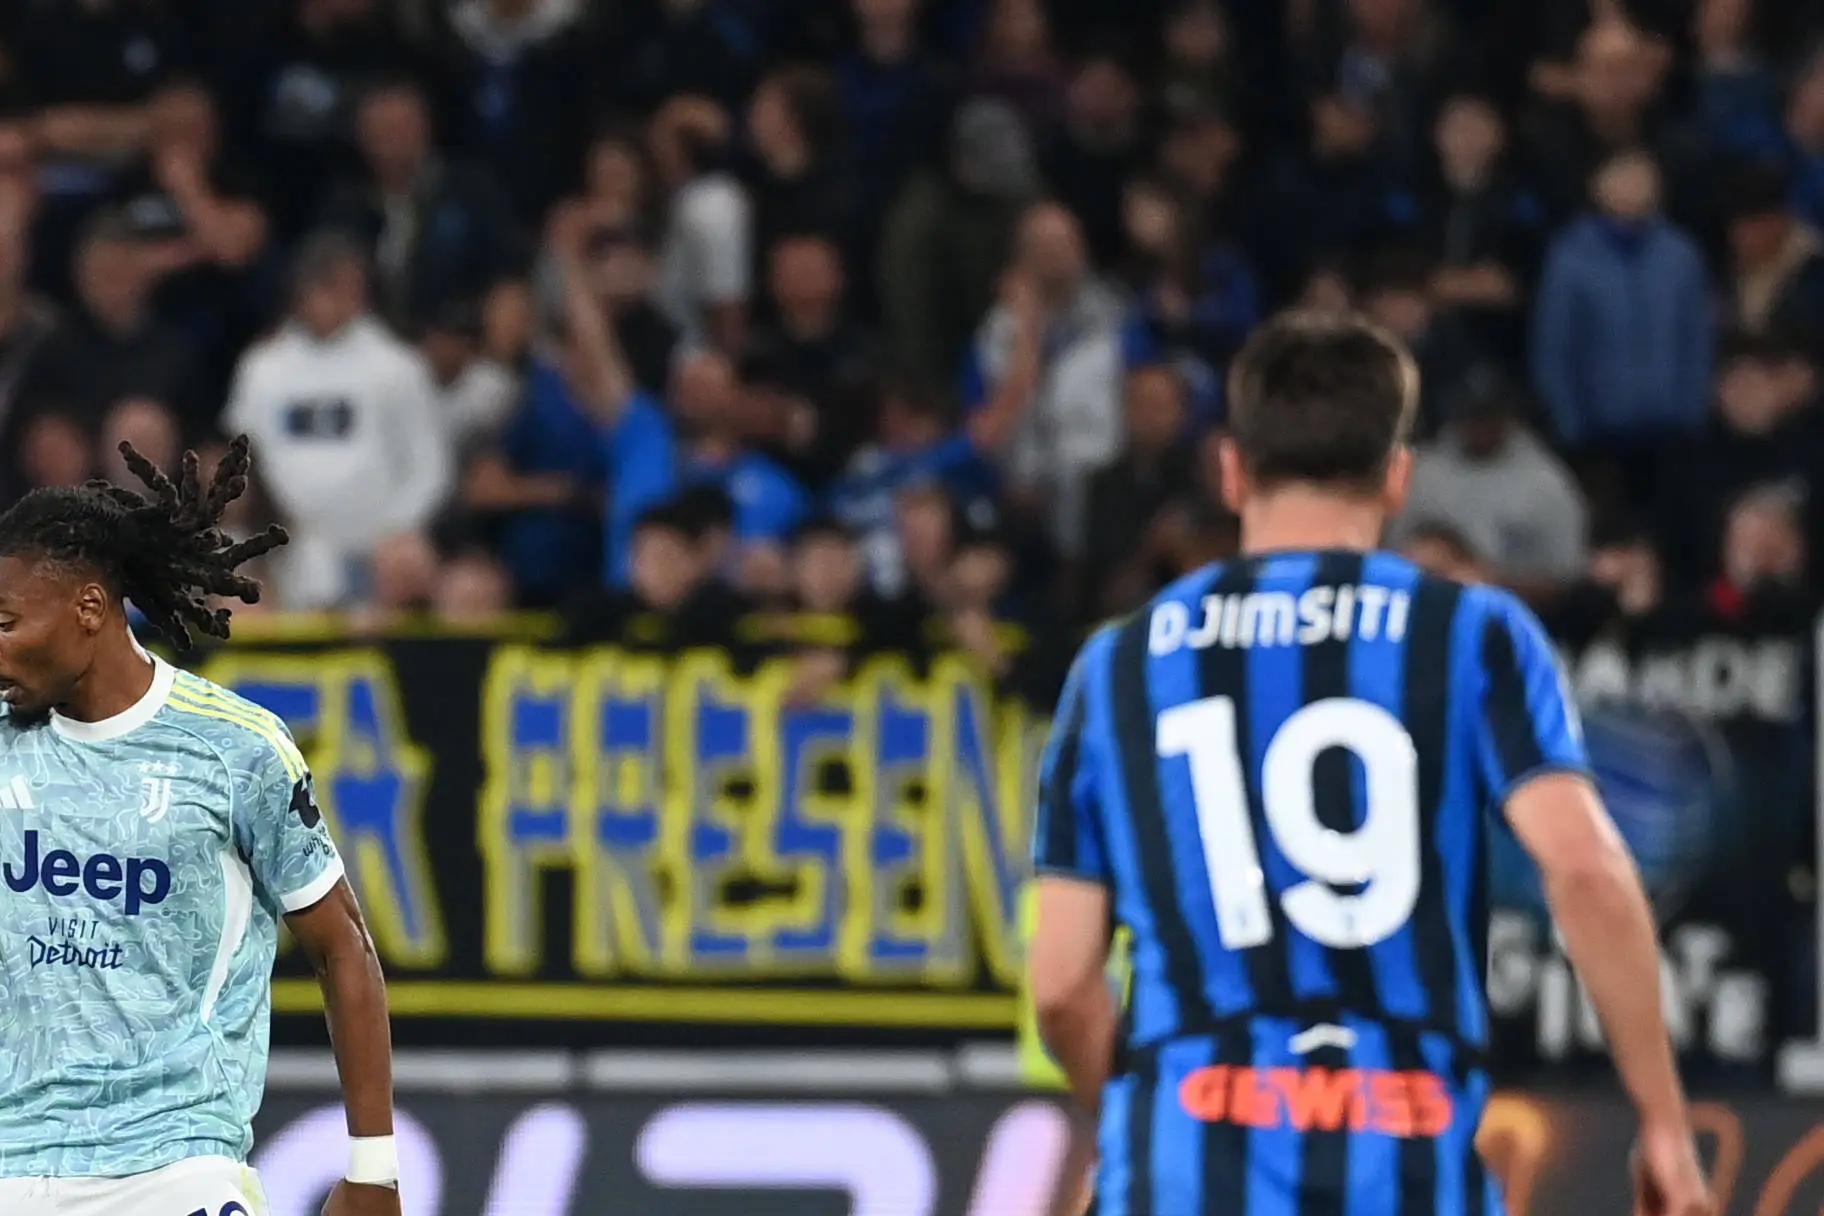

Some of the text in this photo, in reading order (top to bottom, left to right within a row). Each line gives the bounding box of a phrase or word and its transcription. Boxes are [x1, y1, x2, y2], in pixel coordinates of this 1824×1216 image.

[1148, 584, 1410, 656] DJIMSITI
[1155, 693, 1421, 951] 19
[3, 829, 171, 916] Jeep
[26, 935, 124, 971] Detroit
[48, 917, 99, 939] VISIT
[1179, 1064, 1454, 1138] GEWISS
